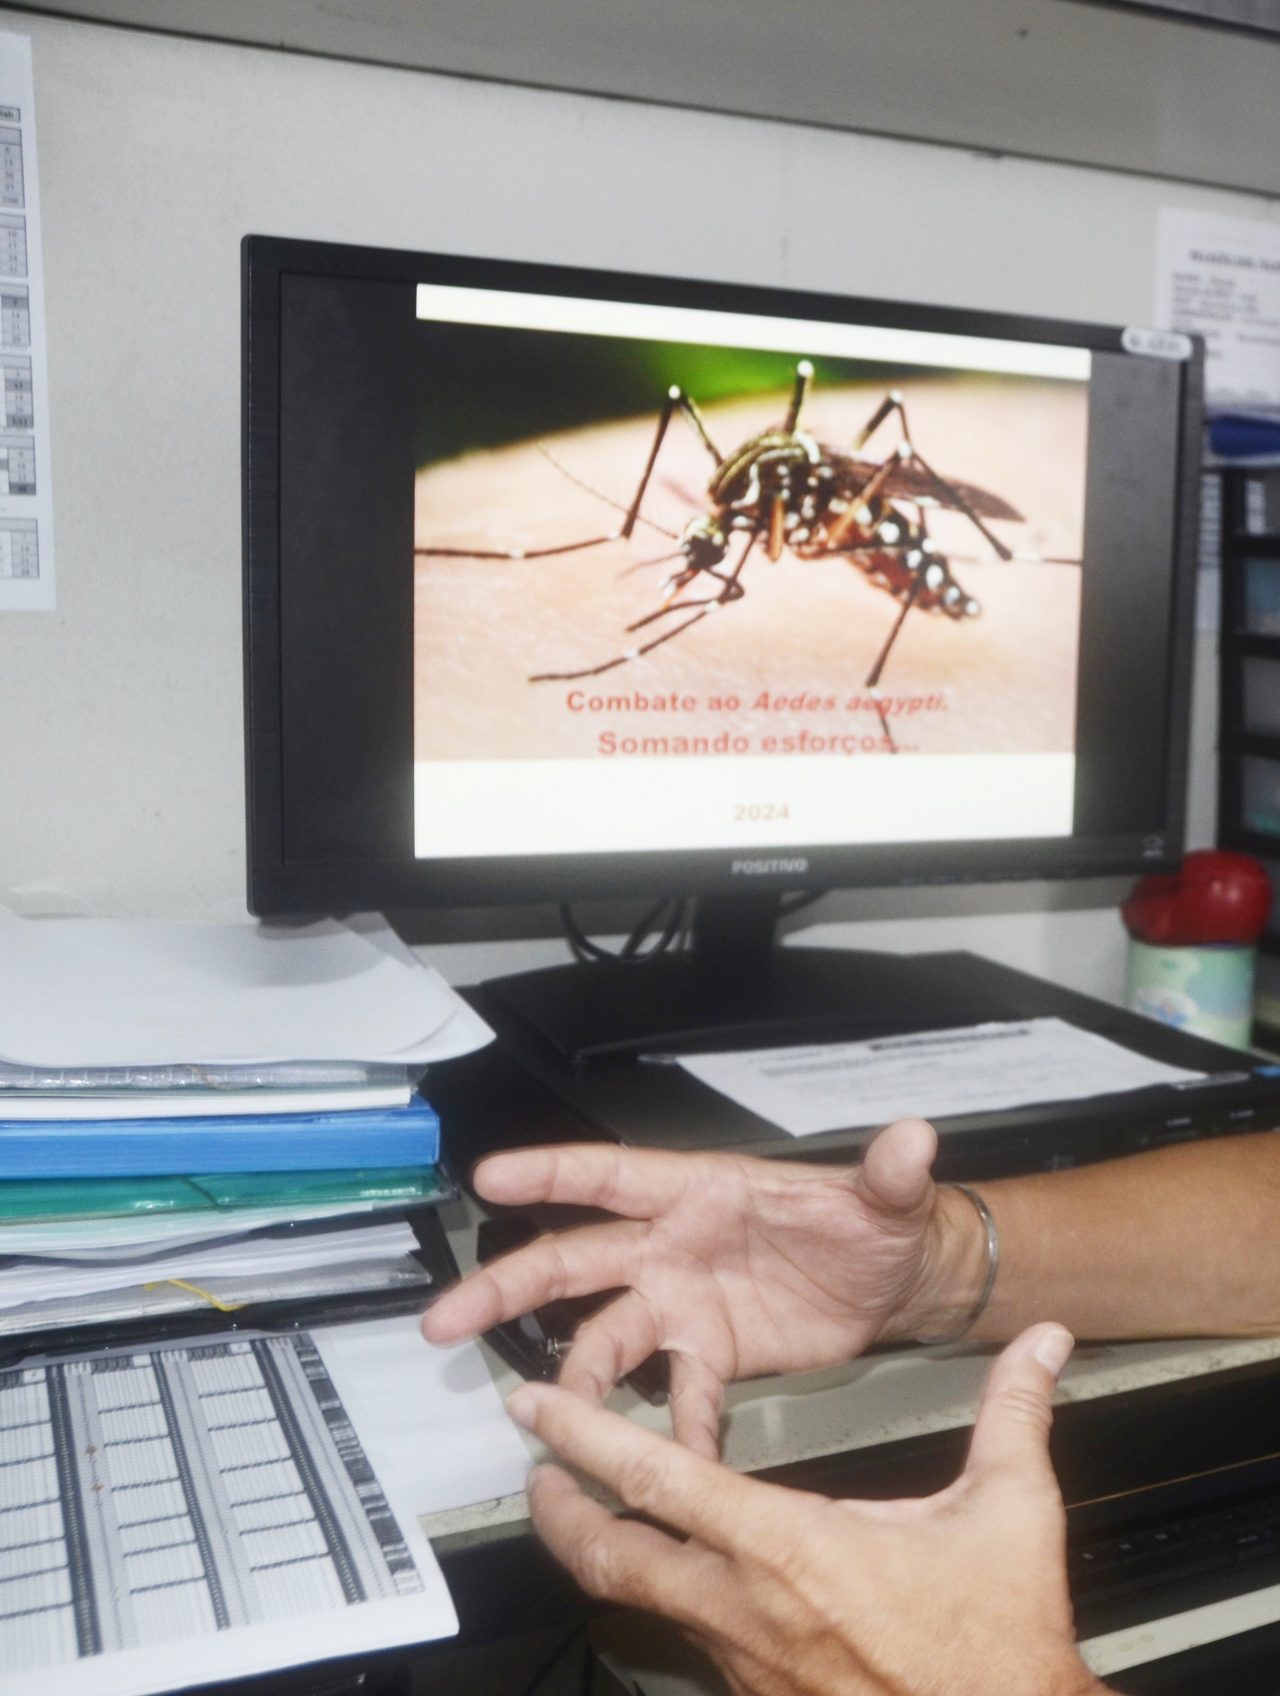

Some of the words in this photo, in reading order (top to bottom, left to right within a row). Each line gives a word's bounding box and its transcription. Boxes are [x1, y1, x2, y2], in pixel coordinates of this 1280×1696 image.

[566, 690, 697, 714] Combate
[707, 694, 740, 712] ao
[750, 691, 836, 712] Aedes
[597, 730, 750, 756] Somando
[733, 803, 791, 822] 2024
[731, 857, 809, 875] POSITIVO
